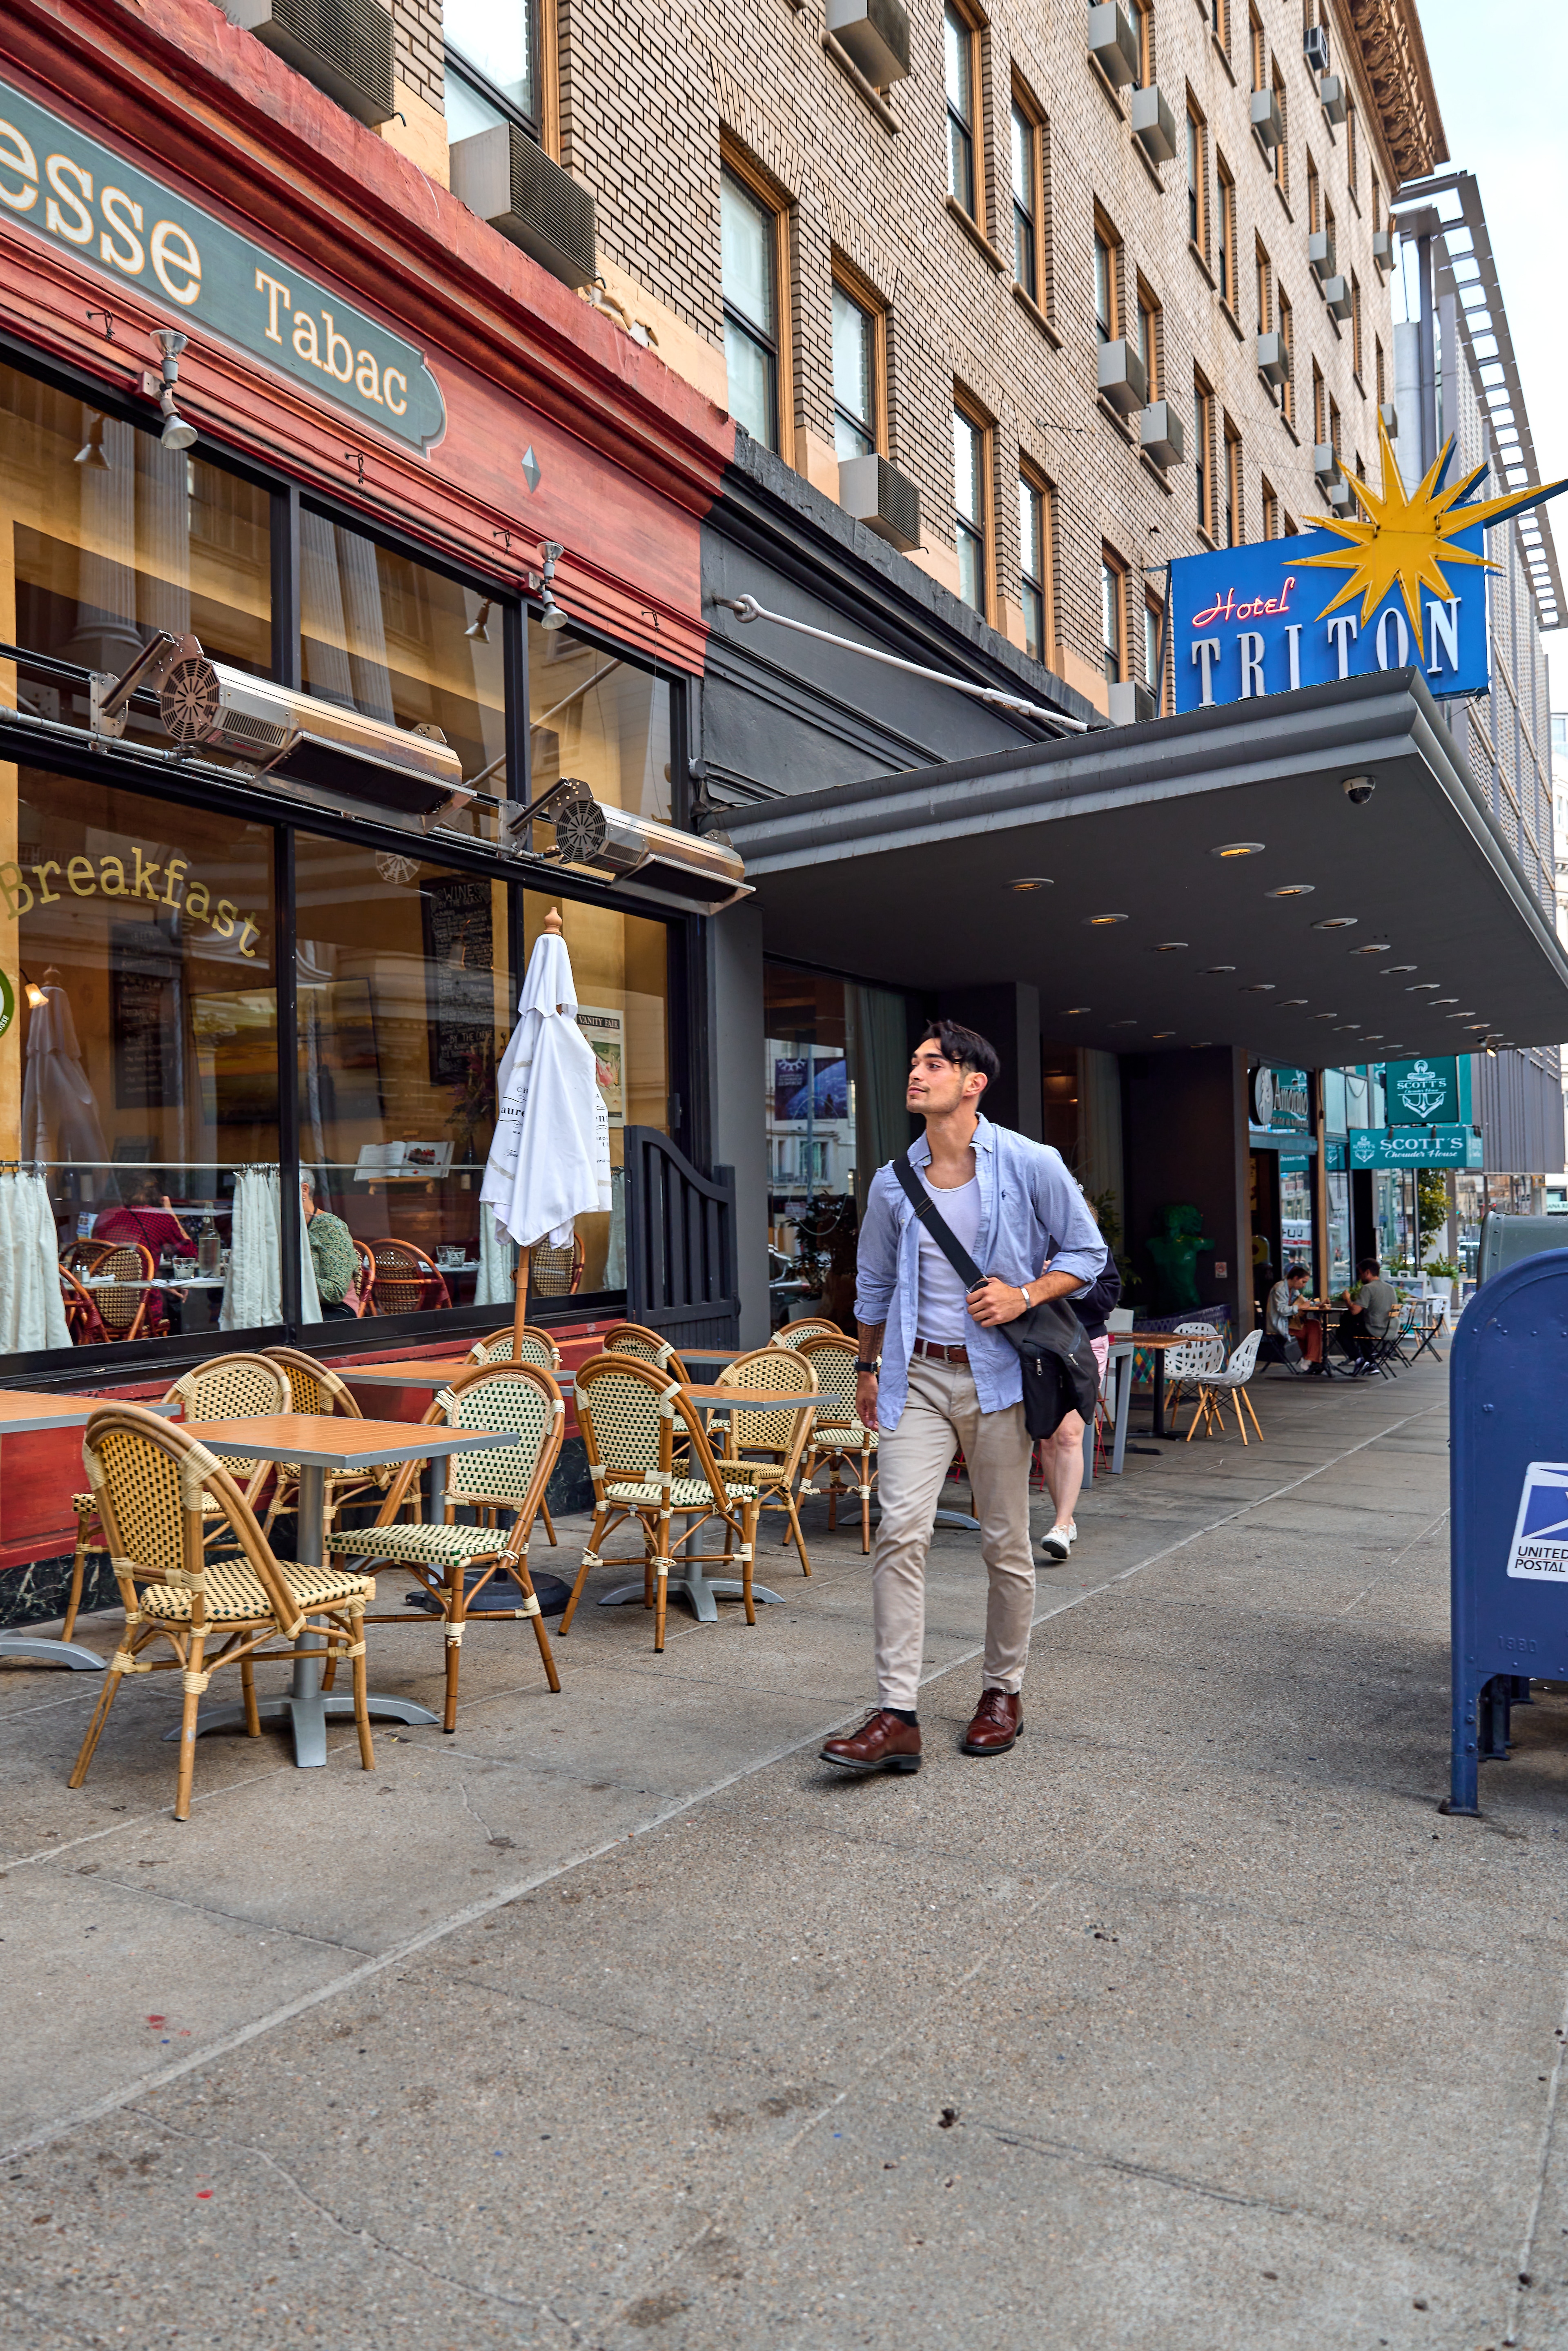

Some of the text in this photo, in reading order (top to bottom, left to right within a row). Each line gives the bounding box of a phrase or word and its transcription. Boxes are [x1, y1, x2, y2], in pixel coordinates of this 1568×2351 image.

[254, 268, 408, 416] Tabac
[1191, 576, 1296, 628] Hotel
[1191, 597, 1462, 708] TRITON
[443, 884, 474, 901] WINE
[0, 847, 261, 957] Breakfast
[579, 1015, 619, 1029] VANITY FAIR
[1396, 1080, 1447, 1090] SCOTT'S
[1380, 1137, 1464, 1150] SCOTT'S
[1385, 1150, 1426, 1159] Chowder
[1518, 1546, 1568, 1559] UNITED
[1515, 1559, 1566, 1572] POSTAL
